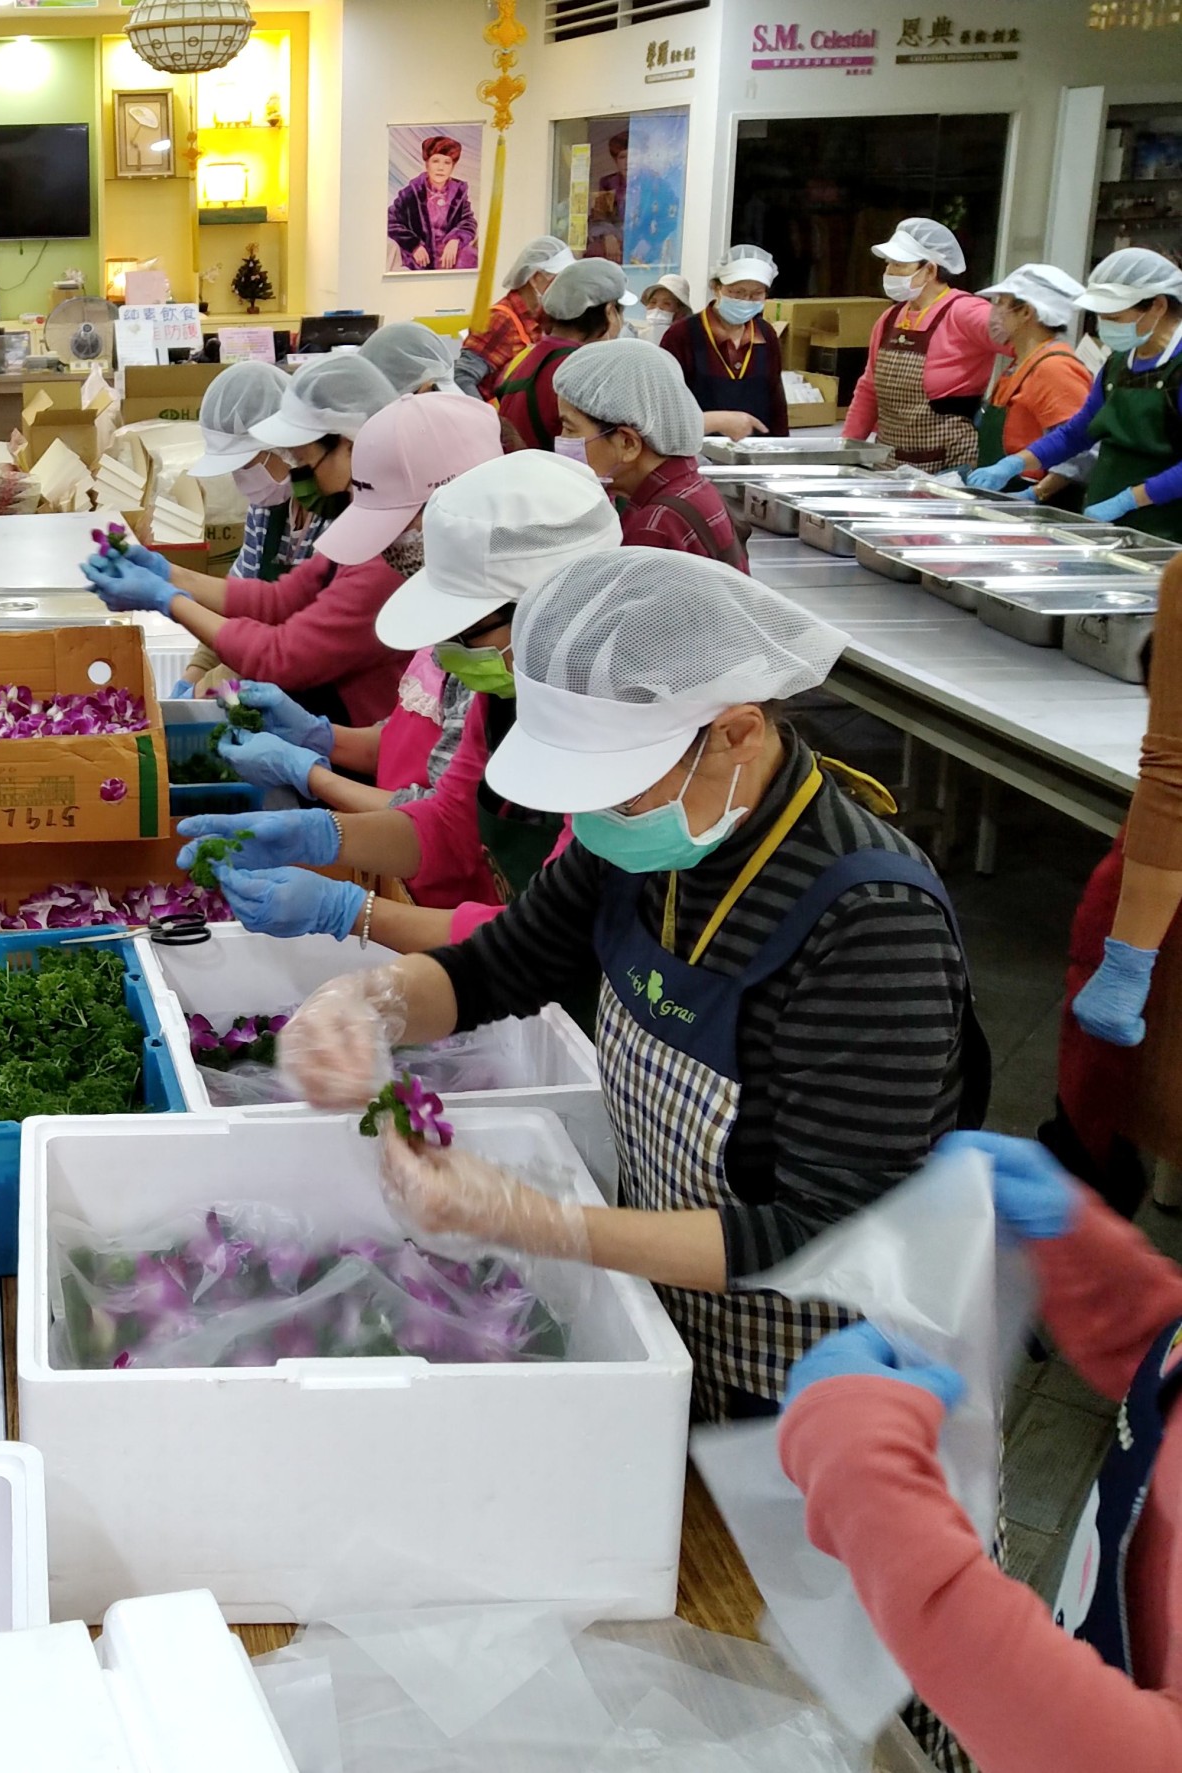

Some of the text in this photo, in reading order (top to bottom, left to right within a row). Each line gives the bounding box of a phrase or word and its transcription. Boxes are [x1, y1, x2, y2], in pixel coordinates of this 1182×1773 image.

[752, 24, 877, 52] S.M. Celestial
[123, 305, 196, 322] 純素飲食
[659, 1000, 697, 1024] Grass
